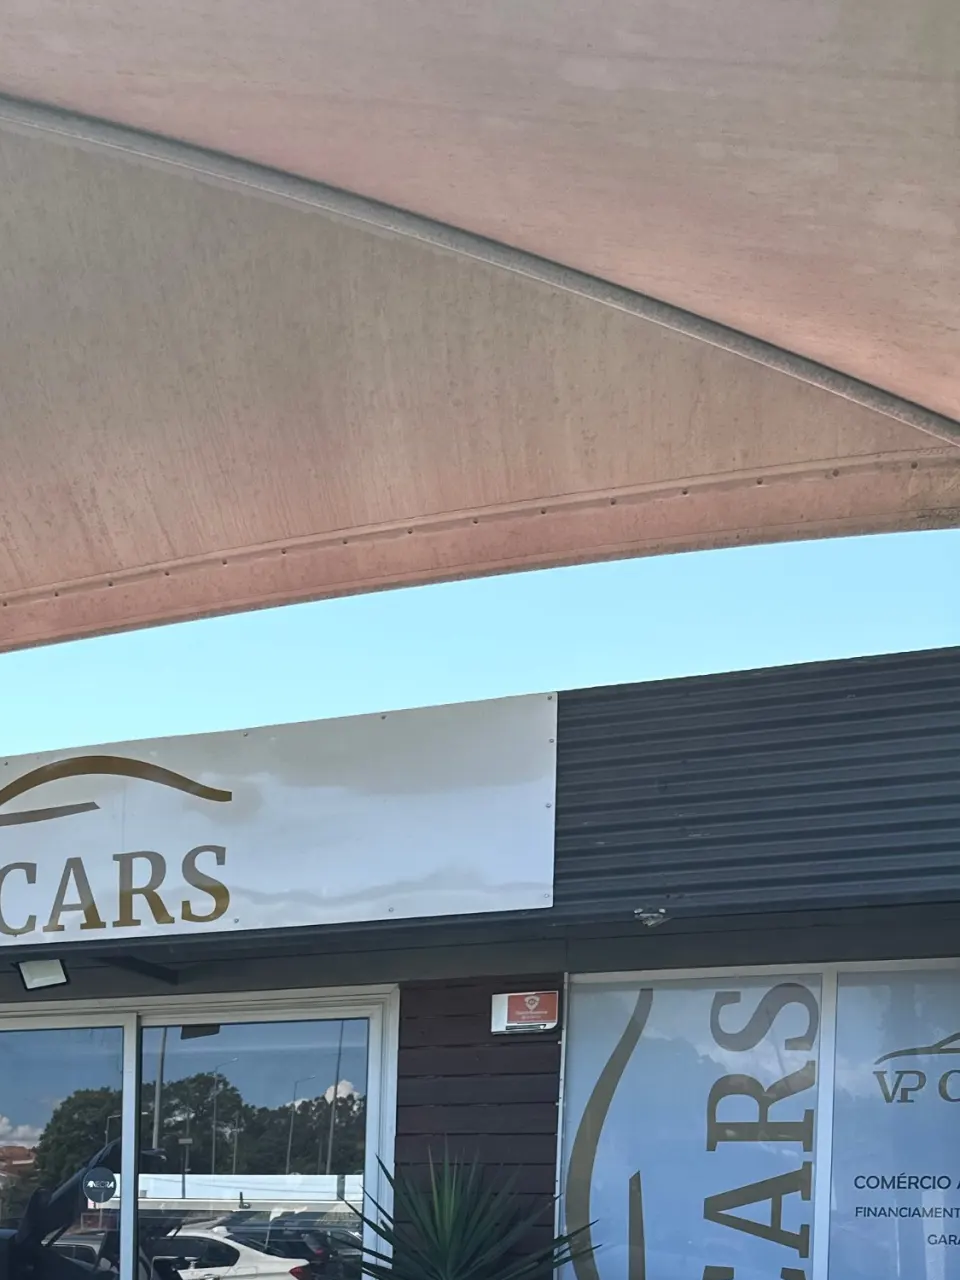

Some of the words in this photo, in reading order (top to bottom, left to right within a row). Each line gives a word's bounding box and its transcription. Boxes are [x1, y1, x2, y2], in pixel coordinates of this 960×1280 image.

[872, 1070, 927, 1103] VP
[853, 1172, 951, 1190] COMÉRCIO
[927, 1233, 960, 1246] GAR
